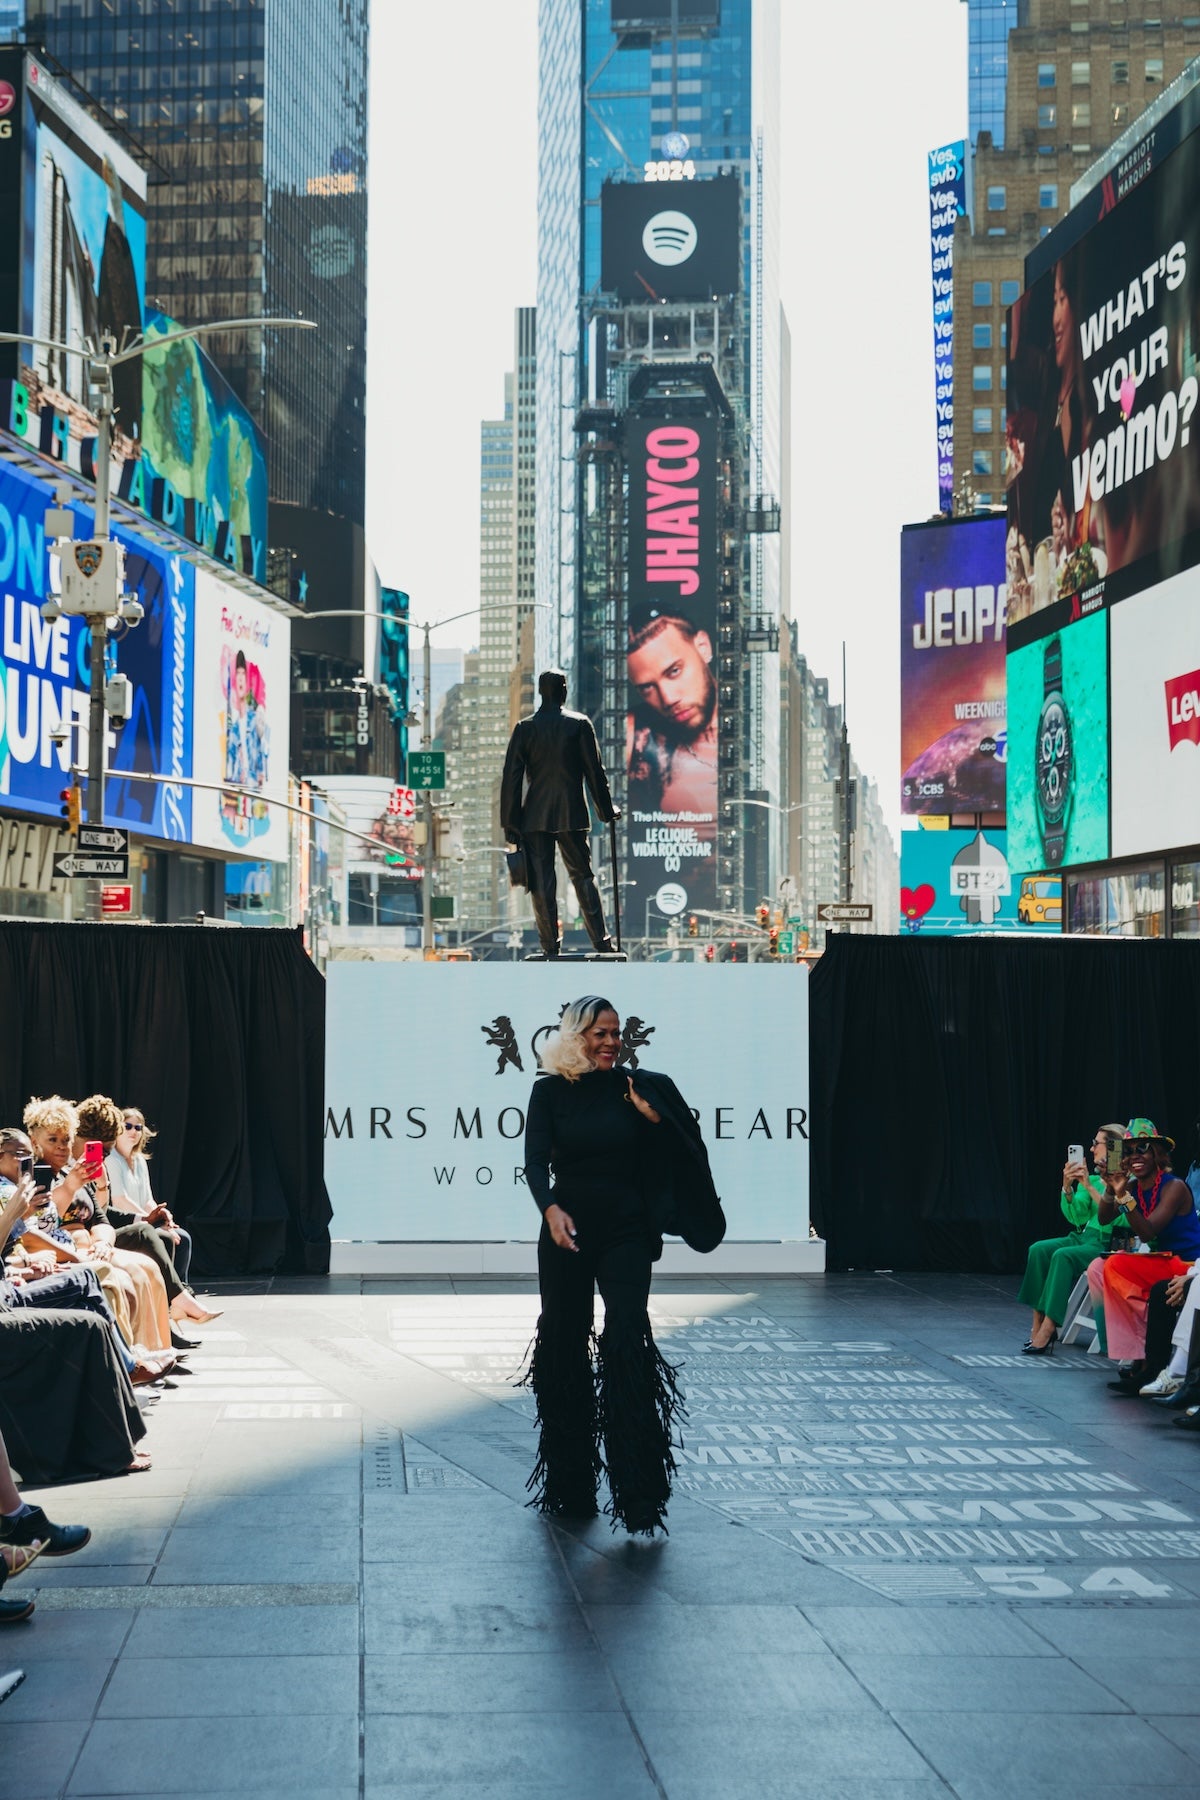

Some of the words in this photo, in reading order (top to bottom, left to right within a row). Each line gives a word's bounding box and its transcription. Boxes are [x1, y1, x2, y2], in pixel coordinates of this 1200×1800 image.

[930, 148, 956, 168] Yes,
[1118, 132, 1156, 179] MARRIOTT
[644, 160, 696, 182] 2024
[931, 164, 957, 187] svb
[1118, 157, 1152, 199] MARQUIS
[931, 190, 958, 211] Yes,
[935, 295, 953, 316] sv
[1080, 241, 1187, 361] WHAT'S
[935, 321, 953, 340] Ye
[1093, 325, 1169, 416] YOUR
[1072, 377, 1199, 514] venmo?
[646, 425, 700, 596] JHAYCO
[4, 594, 70, 679] LIVE
[357, 693, 368, 745] 1500
[980, 742, 996, 752] abc
[421, 755, 432, 764] TO
[412, 766, 419, 775] W
[420, 766, 431, 775] 45
[433, 765, 441, 775] St
[923, 783, 944, 795] CBS
[632, 811, 652, 822] The
[653, 811, 678, 822] New
[679, 811, 713, 822] Album
[85, 832, 100, 844] ONE
[106, 835, 121, 846] WAY
[646, 828, 658, 843] LE
[658, 828, 698, 844] CLIQUE:
[632, 842, 658, 857] VIDA
[658, 842, 712, 857] ROCKSTAR
[63, 860, 85, 871] ONE
[95, 861, 119, 871] WAY
[825, 908, 841, 917] ONE
[848, 908, 866, 917] WAY
[324, 1107, 427, 1139] MRS
[741, 1370, 953, 1383] IMPERIAL
[685, 1386, 810, 1401] ANNE
[810, 1386, 969, 1394] BROOKS
[824, 1392, 982, 1400] ATKINSON
[830, 1409, 1015, 1420] FRIEDMAN
[855, 1424, 1052, 1441] O'NEILL
[842, 1472, 1144, 1492] GERSHWIN
[787, 1500, 1195, 1523] SIMON
[790, 1529, 1079, 1557] BROADWAY
[1079, 1529, 1200, 1543] AUGUS
[972, 1567, 1174, 1599] 54
